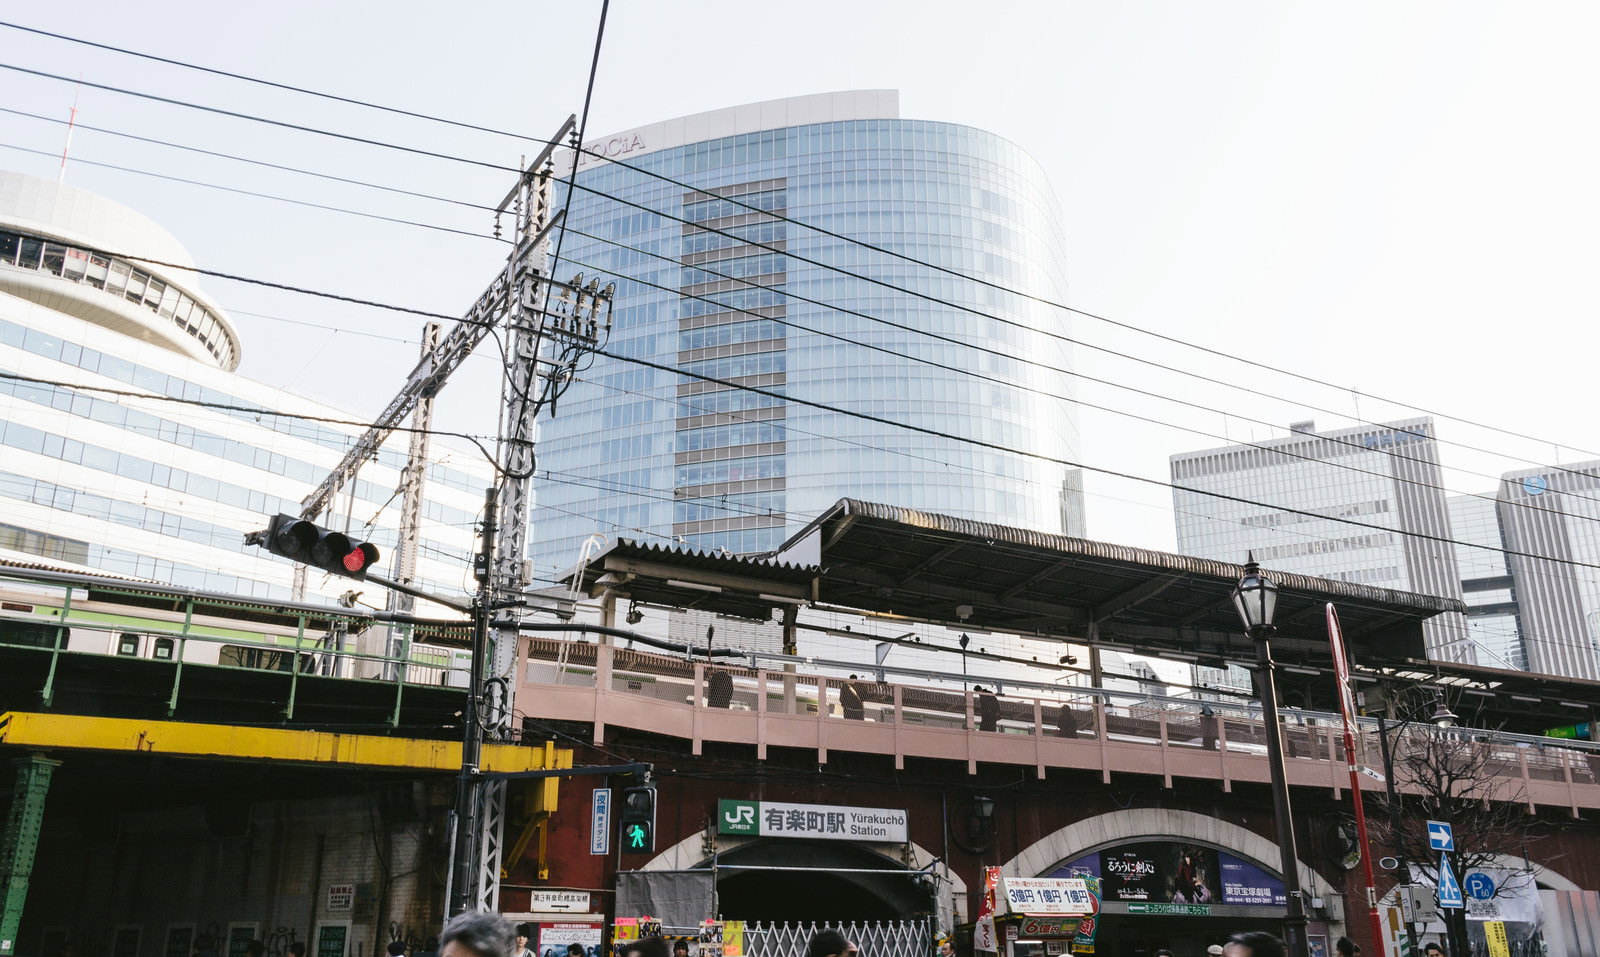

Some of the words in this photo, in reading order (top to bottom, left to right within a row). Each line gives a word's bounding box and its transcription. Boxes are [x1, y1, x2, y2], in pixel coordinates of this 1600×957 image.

[725, 805, 755, 825] JR
[764, 808, 846, 834] 有楽町駅
[850, 812, 905, 826] Yūrakuchō
[850, 824, 887, 837] Station
[1107, 861, 1155, 873] るろうに剣心
[1009, 888, 1035, 903] 3億円
[1037, 889, 1062, 903] 1億円
[1064, 889, 1089, 903] 1億円
[1471, 880, 1483, 897] P
